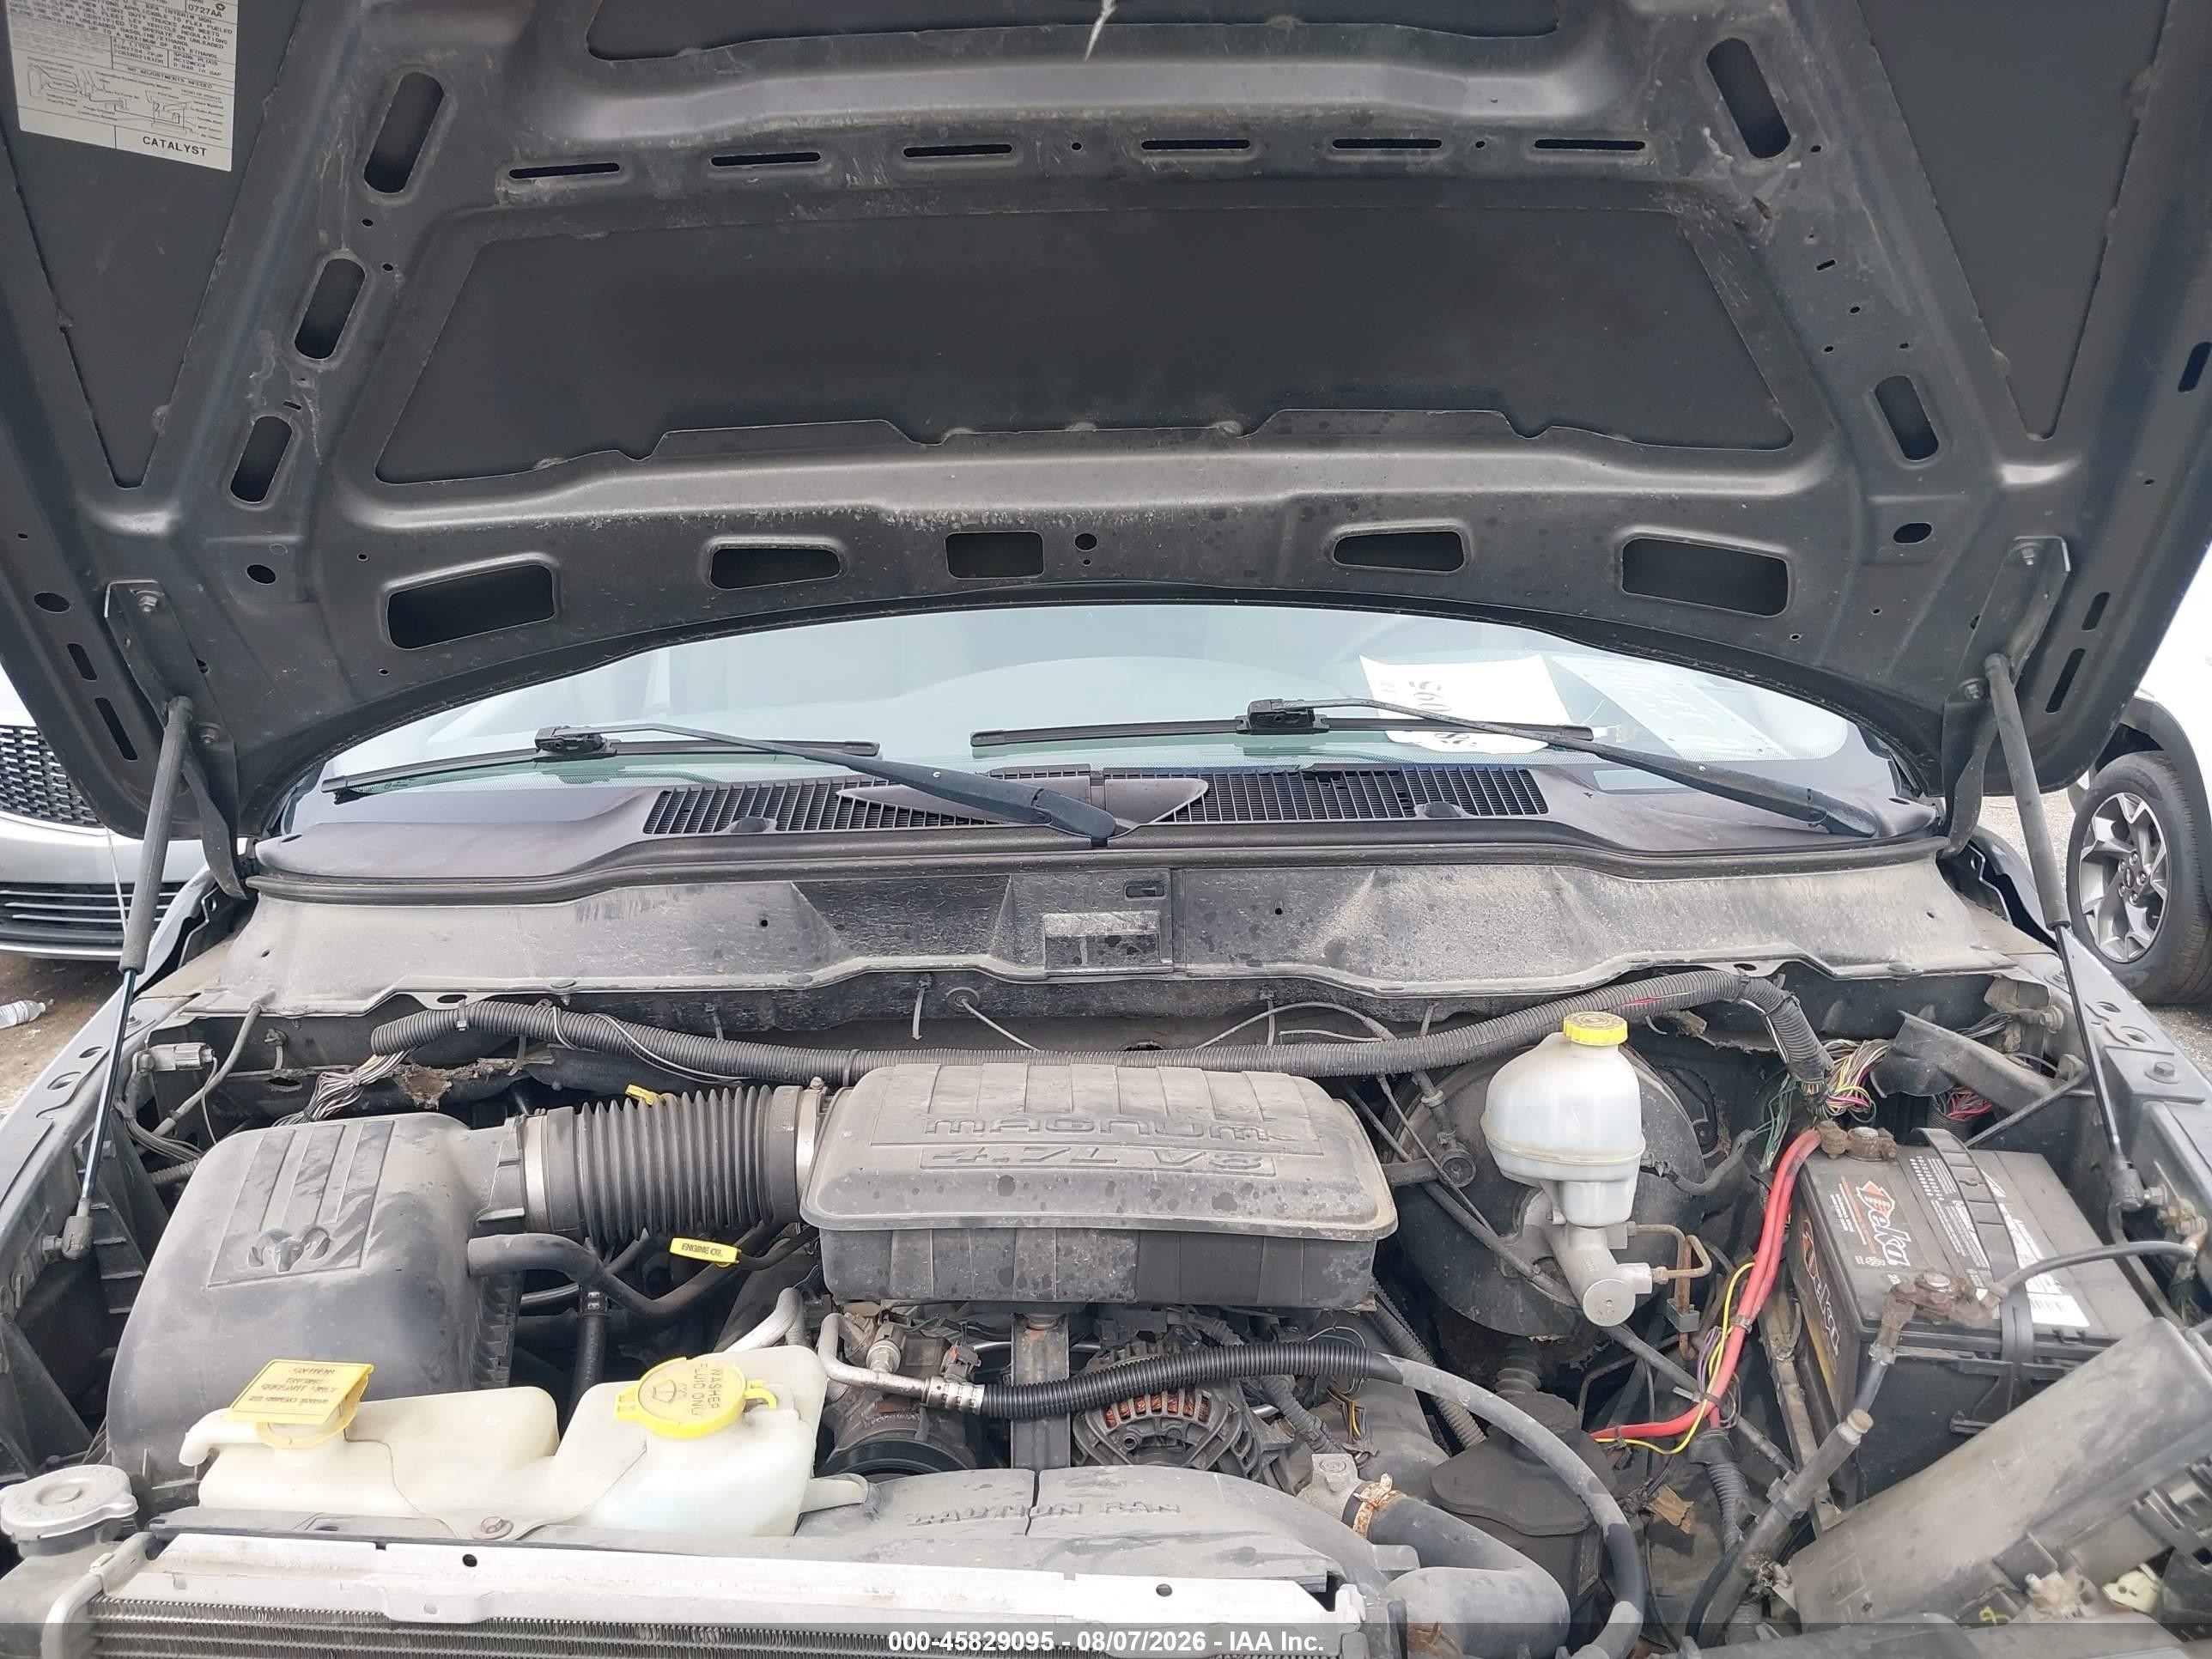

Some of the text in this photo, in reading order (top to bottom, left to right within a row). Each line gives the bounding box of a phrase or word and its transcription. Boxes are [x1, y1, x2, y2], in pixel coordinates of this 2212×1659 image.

[128, 11, 145, 20] DUTY
[188, 4, 222, 18] 0727AA
[146, 21, 177, 32] VEHICLE
[180, 29, 228, 44] REGULATIONS
[206, 24, 232, 33] FUELED
[142, 26, 173, 37] OPERATE
[189, 37, 223, 49] UNLEADED
[189, 48, 218, 58] ETHANOL
[143, 137, 207, 156] CATALYST
[681, 1243, 724, 1257] ENGINE OIL
[707, 1368, 724, 1409] WASHER
